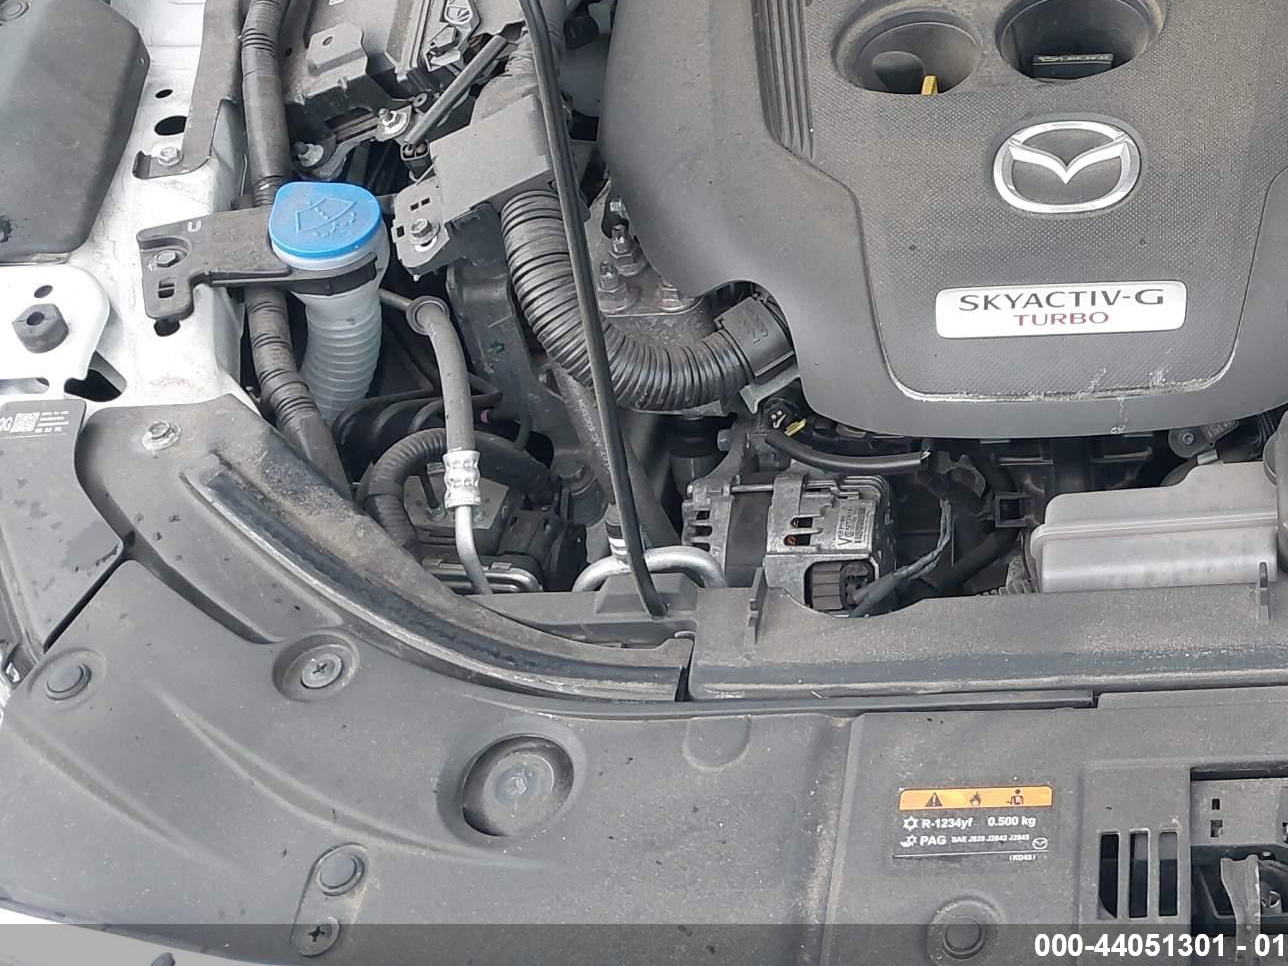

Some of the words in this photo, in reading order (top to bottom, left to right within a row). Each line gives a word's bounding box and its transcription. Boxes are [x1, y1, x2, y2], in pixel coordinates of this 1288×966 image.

[958, 289, 1165, 312] SKYACTIV-G
[1013, 312, 1110, 327] TURBO
[921, 817, 974, 830] R-1234yf
[987, 817, 1018, 827] 0.500
[1021, 816, 1037, 828] kg
[920, 835, 947, 847] PAG
